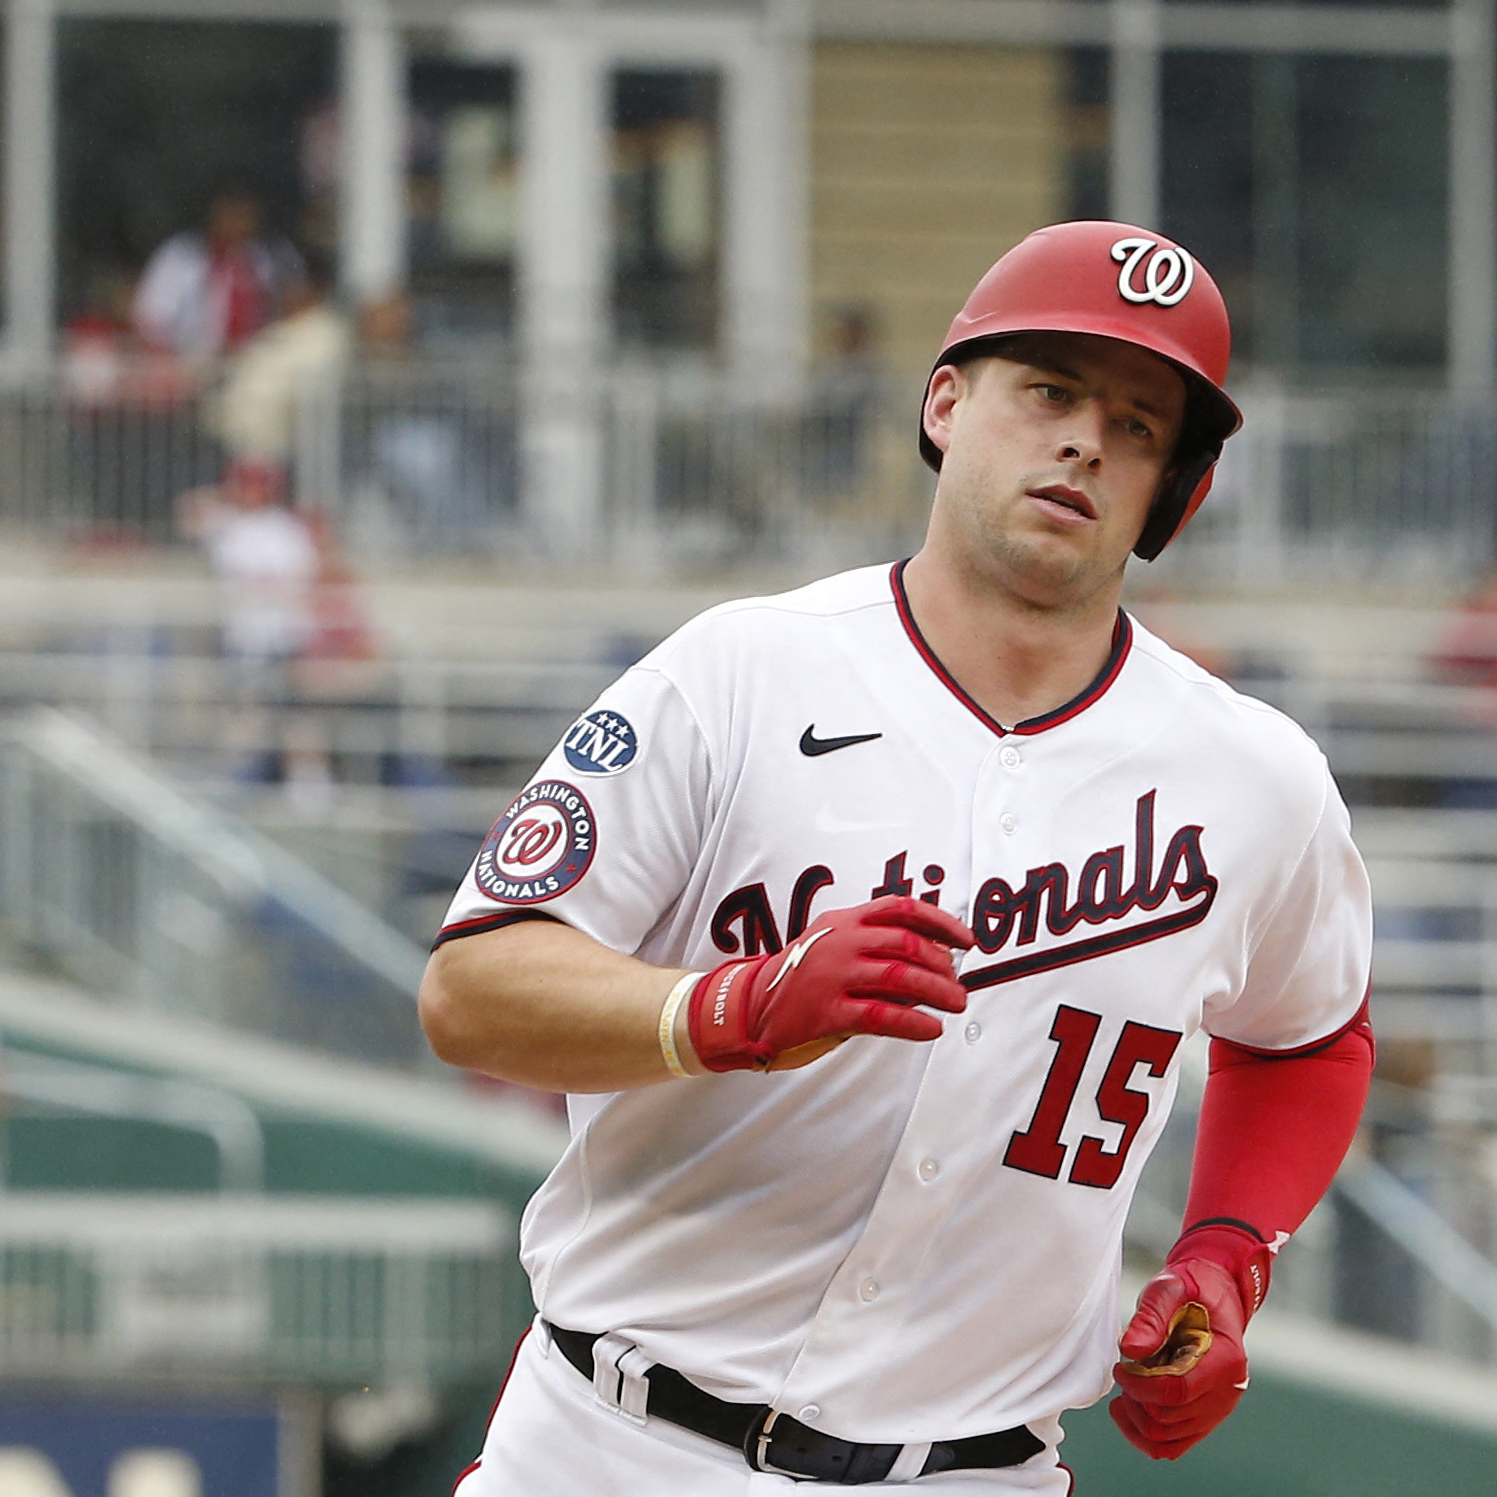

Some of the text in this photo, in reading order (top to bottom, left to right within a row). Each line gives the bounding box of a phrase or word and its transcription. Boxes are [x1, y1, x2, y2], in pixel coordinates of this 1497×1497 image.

[1110, 237, 1195, 307] W
[566, 718, 629, 772] TNL
[506, 783, 591, 852] WASHINGTON
[477, 849, 560, 899] NATIONALS
[709, 787, 1218, 958] Ntionals
[1001, 1003, 1184, 1190] 15
